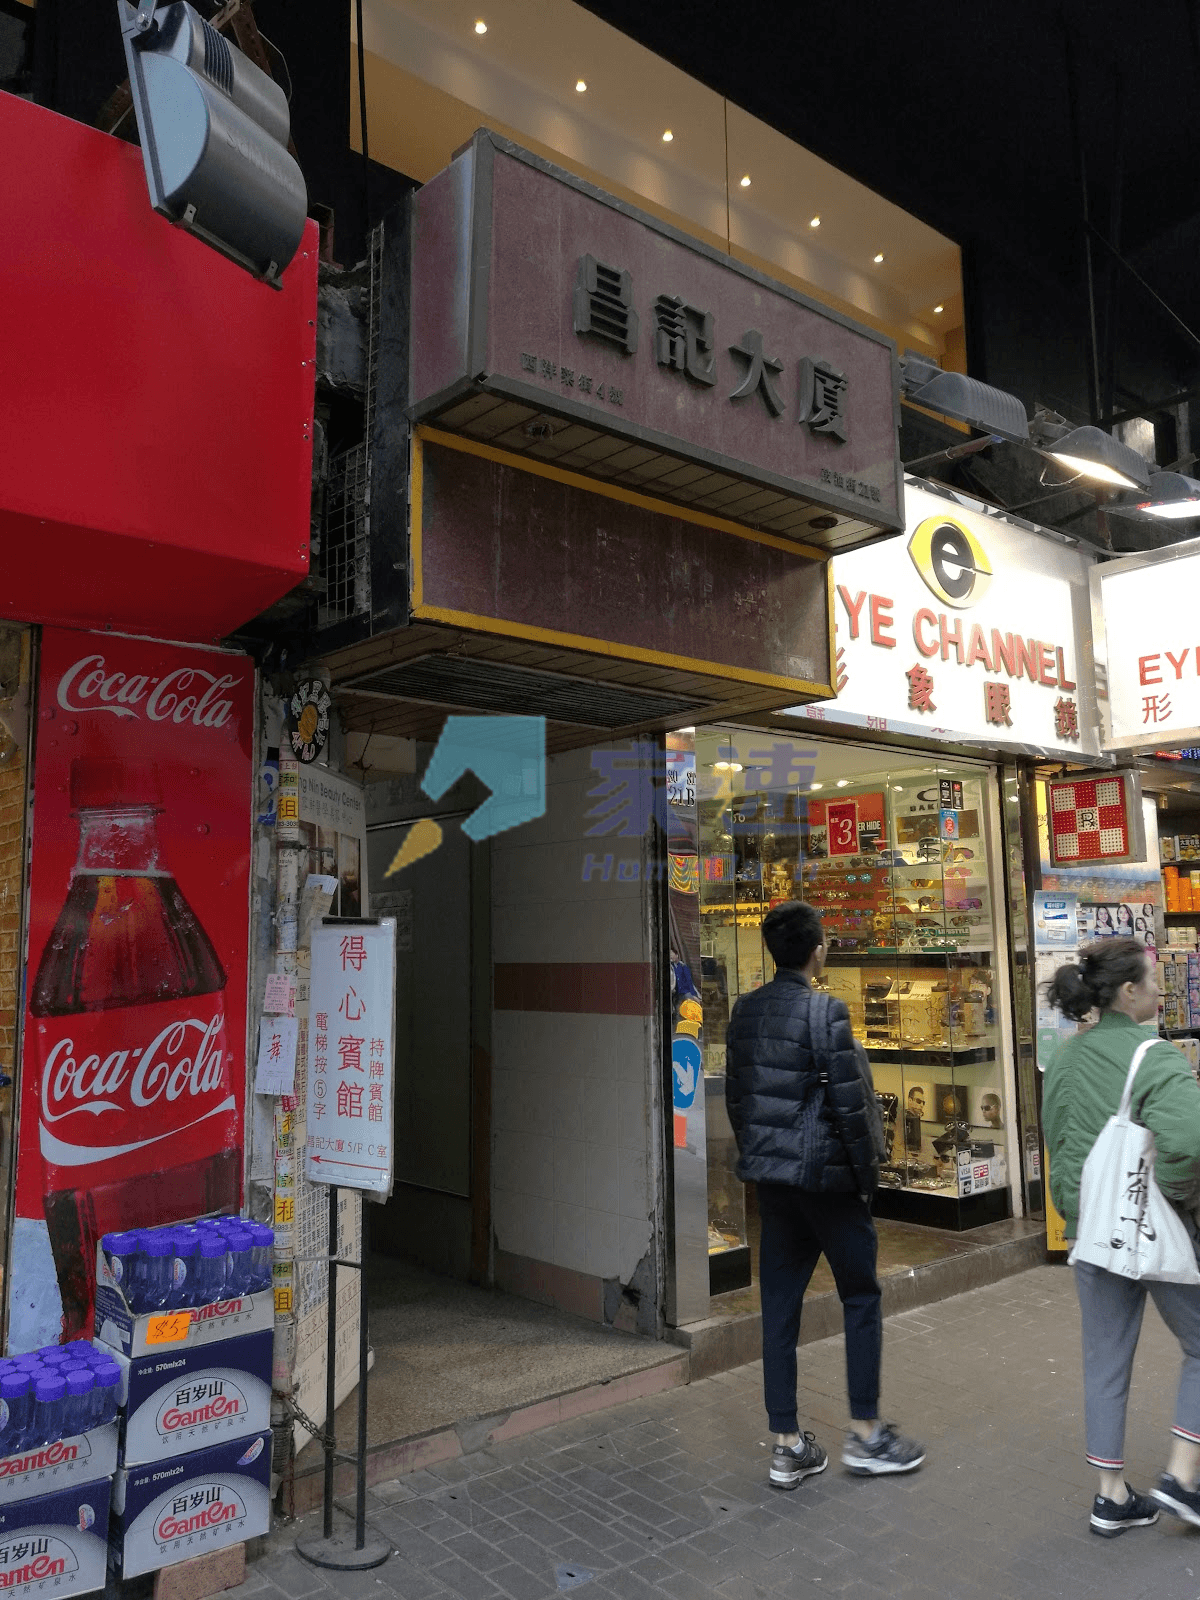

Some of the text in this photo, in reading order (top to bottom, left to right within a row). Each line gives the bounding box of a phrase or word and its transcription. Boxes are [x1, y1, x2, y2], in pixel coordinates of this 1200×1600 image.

[572, 252, 848, 444] 昌記大廈
[835, 584, 1077, 692] YE CHANNEL
[1138, 645, 1200, 687] EY
[57, 654, 244, 728] Coca-Cola
[1142, 692, 1173, 724] 形
[341, 791, 361, 812] Center
[837, 818, 853, 845] 3
[866, 820, 881, 831] HIDE
[337, 935, 368, 1119] 得心賓館
[41, 1012, 225, 1123] Coca-Cola
[367, 1037, 385, 1123] 持牌賓館
[307, 1134, 345, 1153] 昌記大廈
[347, 1141, 363, 1154] 5/F
[367, 1144, 375, 1156] C
[376, 1143, 388, 1159] 室
[175, 1380, 223, 1407] 百岁山
[161, 1415, 247, 1444] 饮用天然矿泉水
[162, 1396, 239, 1430] Ganten
[7, 1458, 90, 1487] 用天然矿泉水
[172, 1486, 221, 1516] 百岁山
[158, 1501, 236, 1539] Ganten
[159, 1519, 246, 1554] 饮用天然矿泉水
[0, 1538, 50, 1564] 百岁山
